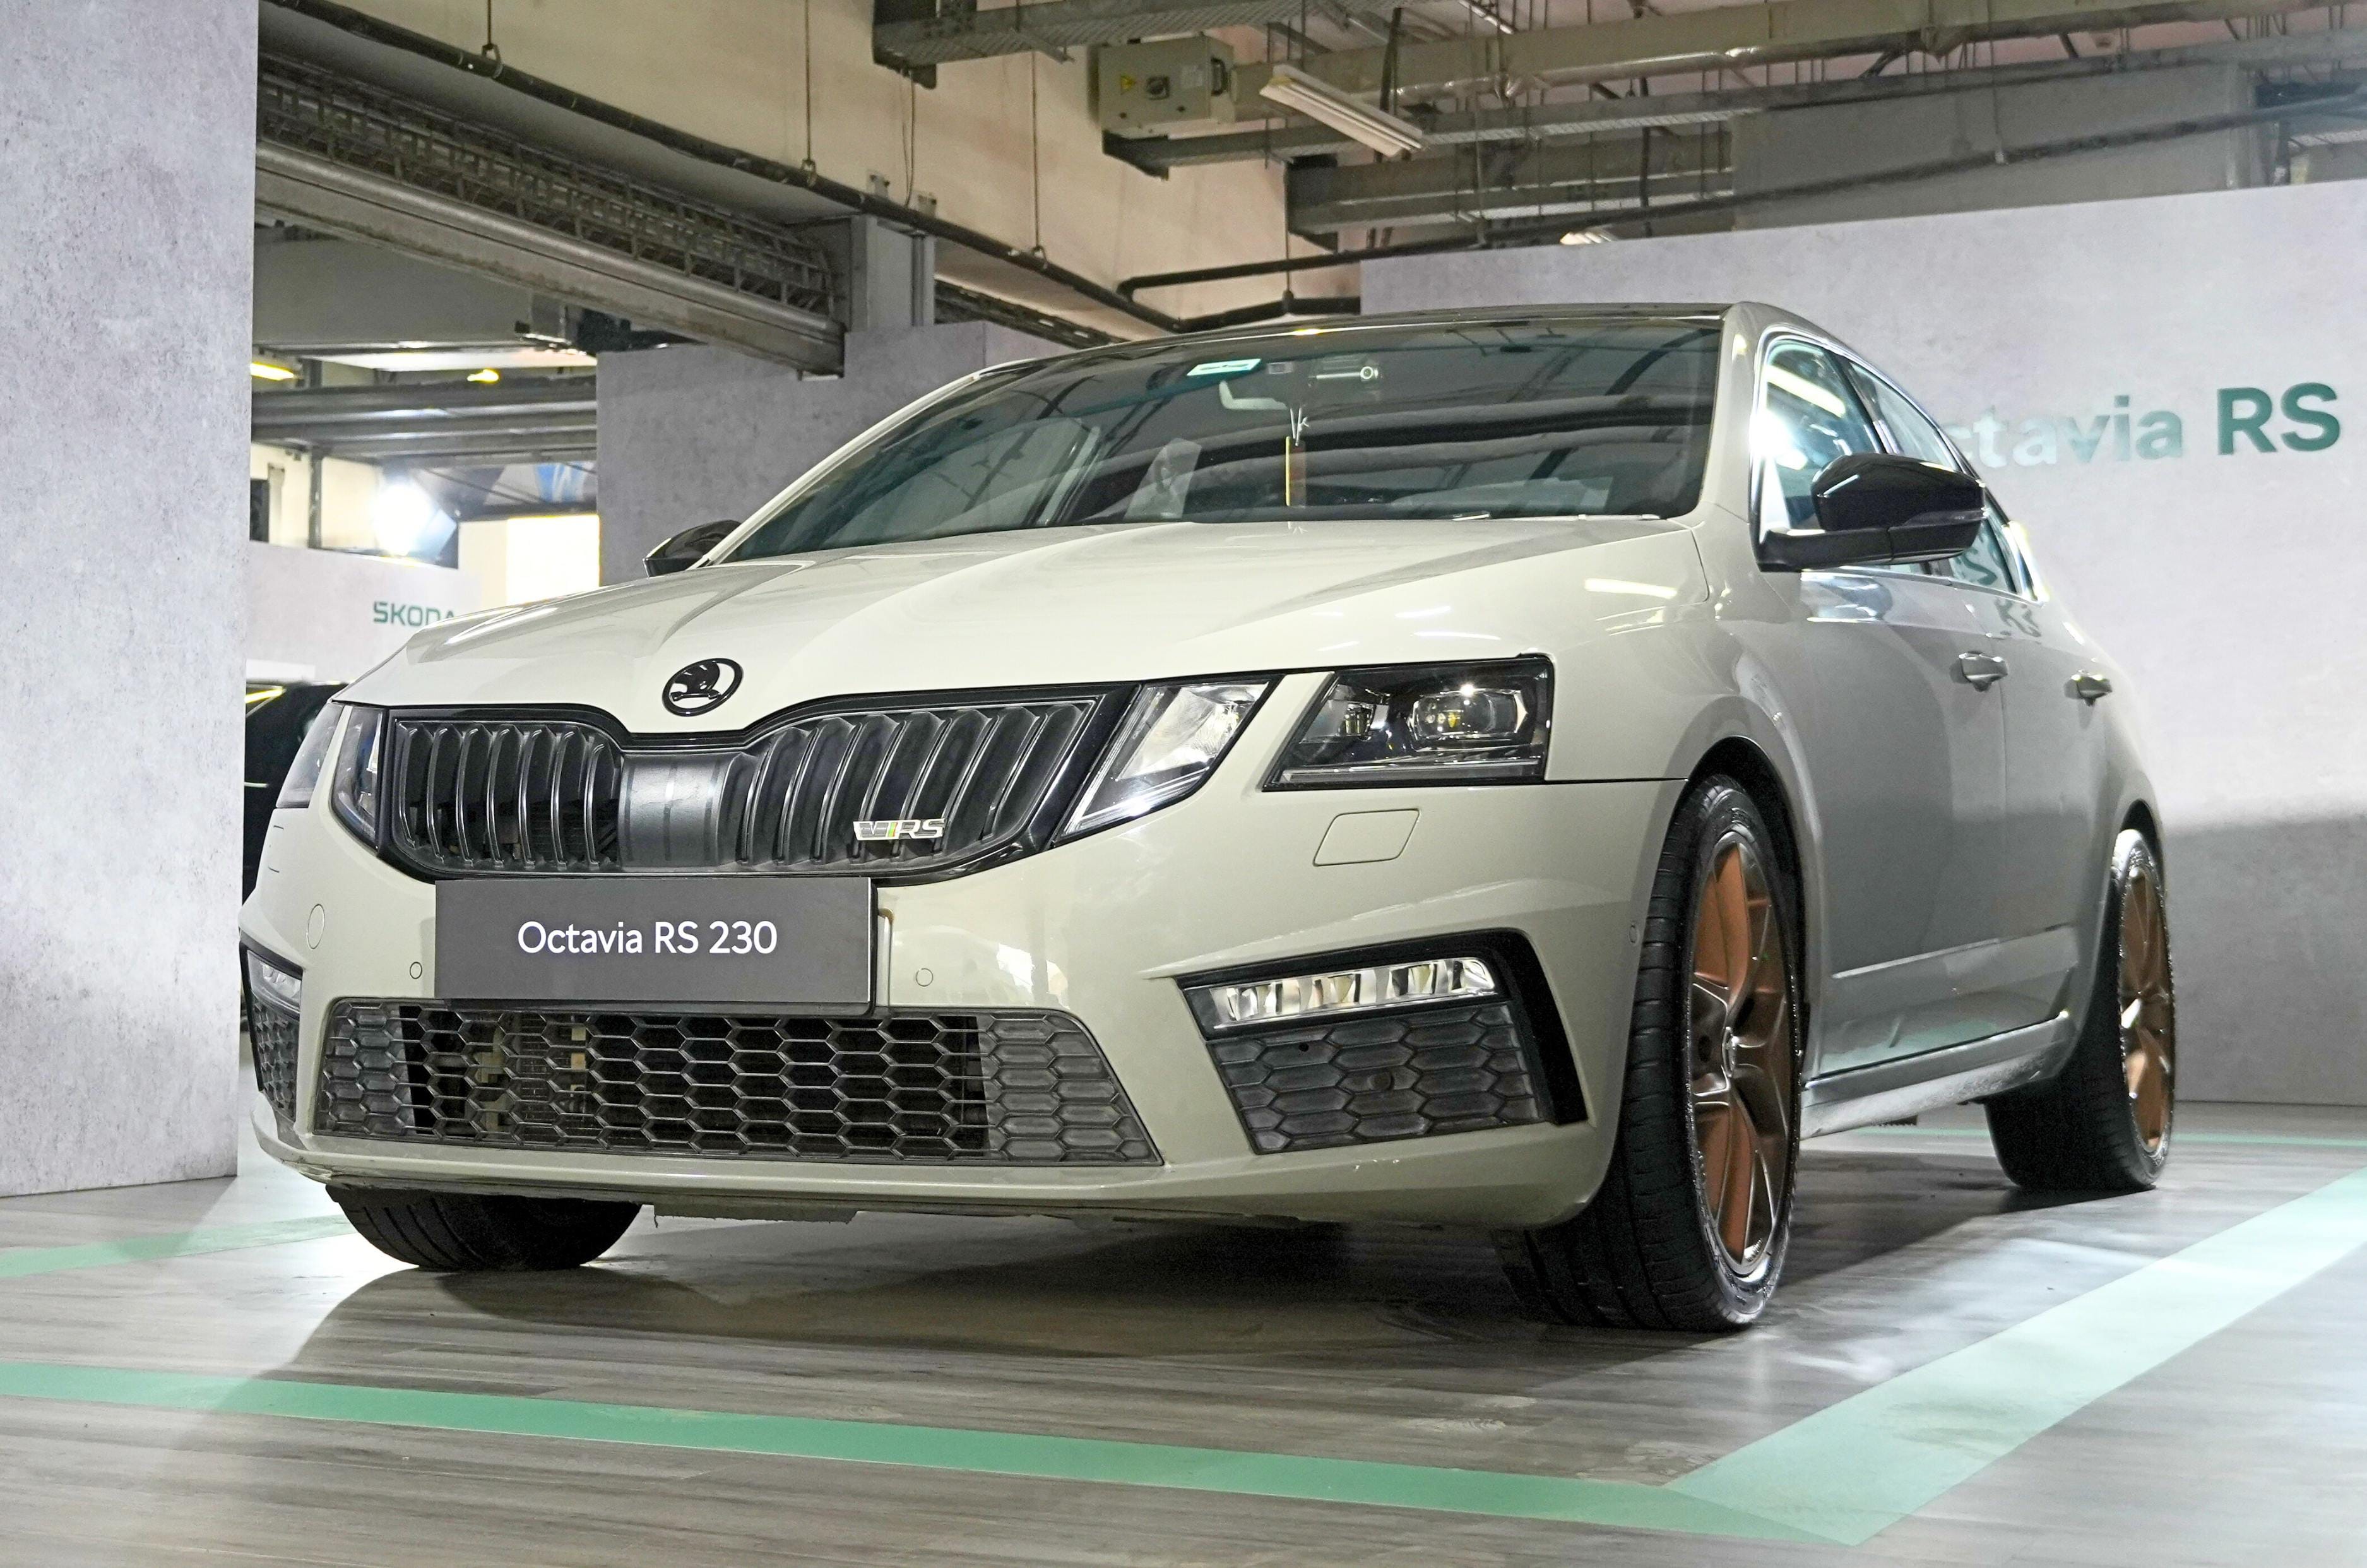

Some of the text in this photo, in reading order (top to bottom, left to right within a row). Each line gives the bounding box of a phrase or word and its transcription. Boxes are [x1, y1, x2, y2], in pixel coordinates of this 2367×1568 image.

[2216, 382, 2342, 455] RS
[517, 920, 778, 954] Octavia RS 230
